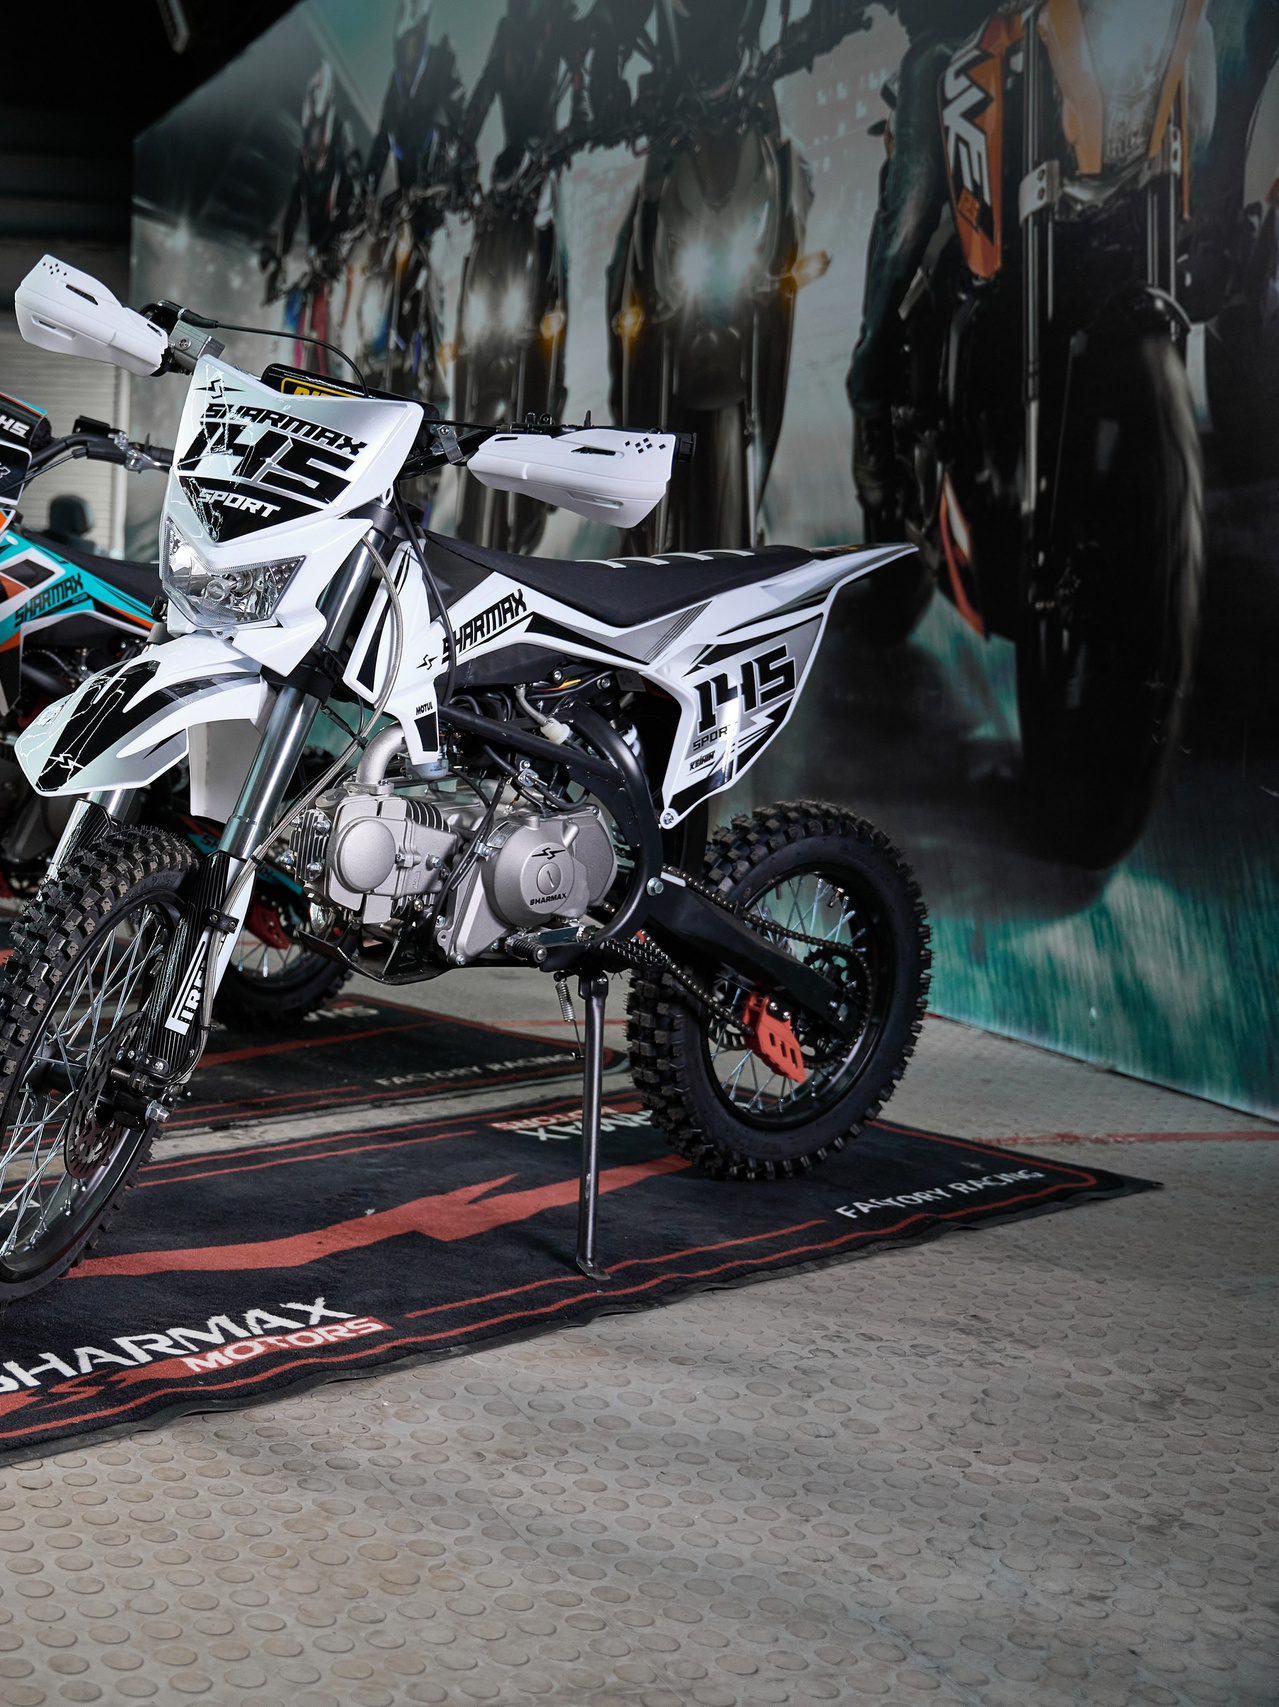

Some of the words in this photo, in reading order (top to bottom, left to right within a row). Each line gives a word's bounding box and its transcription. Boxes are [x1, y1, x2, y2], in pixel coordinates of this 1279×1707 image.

[201, 403, 367, 456] SHARMAX
[178, 419, 356, 506] 145
[197, 488, 281, 518] SPORT
[14, 572, 83, 628] SHARMAX
[442, 588, 527, 665] SHARMAX
[416, 702, 433, 715] MOTUL
[694, 644, 795, 734] 145
[530, 893, 566, 905] SHARMAX
[374, 1066, 482, 1086] FACTORY
[487, 1054, 574, 1072] RACING
[835, 1188, 953, 1219] FACTORY
[949, 1168, 1046, 1195] RACING
[184, 1316, 385, 1373] MOTORS
